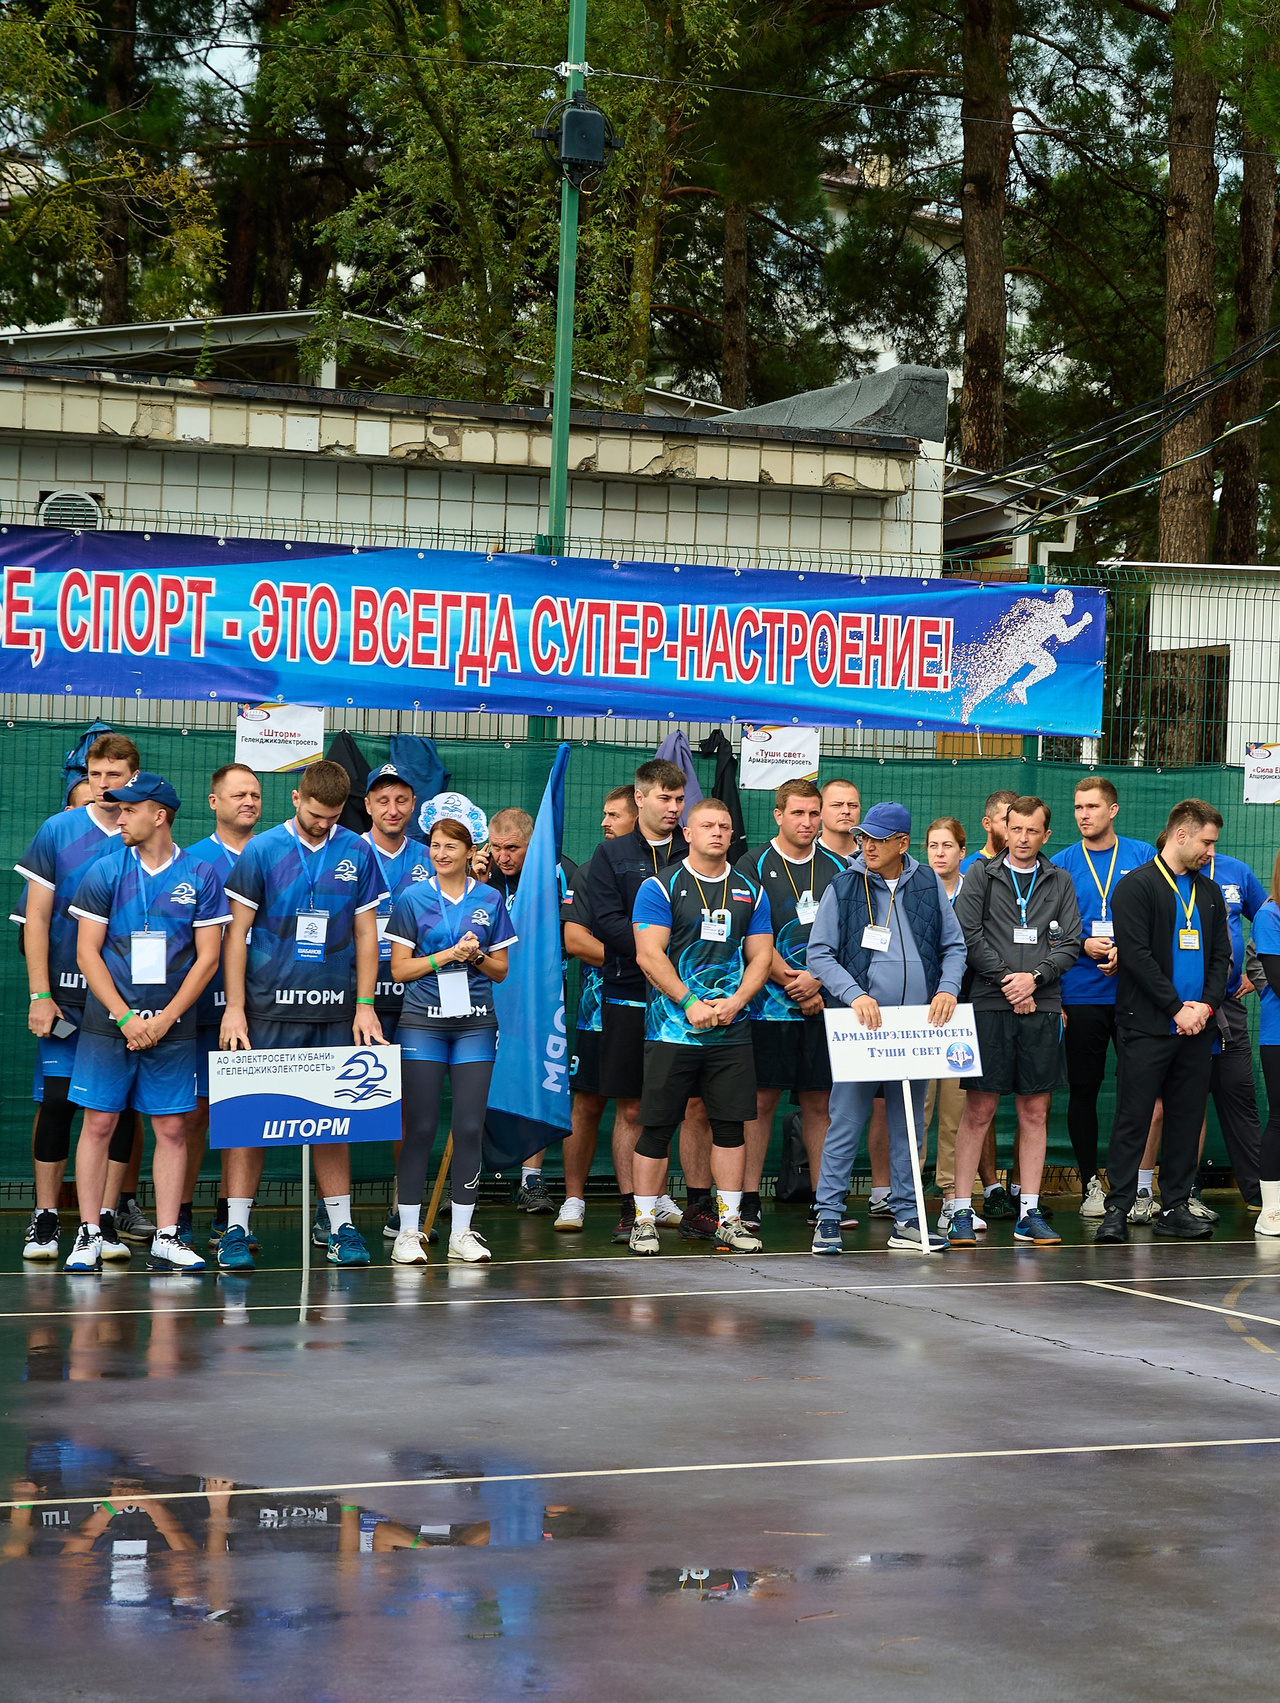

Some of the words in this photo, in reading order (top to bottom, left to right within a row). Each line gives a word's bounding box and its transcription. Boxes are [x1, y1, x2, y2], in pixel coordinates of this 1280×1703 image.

[58, 568, 216, 657] СПОРТ
[248, 579, 341, 665] ЭТО
[349, 585, 521, 687] ВСЕГДА
[529, 595, 955, 693] СУПЕР-НАСТРОЕНИЕ!
[241, 735, 318, 746] Геленджикэлектросеть
[259, 729, 301, 739] «Шторм»
[748, 756, 812, 766] Армавирэлектросеть
[755, 749, 781, 760] «Туши
[783, 751, 806, 759] свет»
[275, 989, 345, 1005] ШТОРМ
[427, 1004, 488, 1019] ШРМ
[216, 1056, 229, 1064] АО
[232, 1053, 296, 1064] «ЭЛЕКТРОСЕТИ
[298, 1051, 335, 1062] КУБАНИ»
[216, 1063, 336, 1076] «ГЕЛЕНДЖИКЭЛЕКТРОСЕТЬ»
[262, 1117, 350, 1139] ШТОРМ
